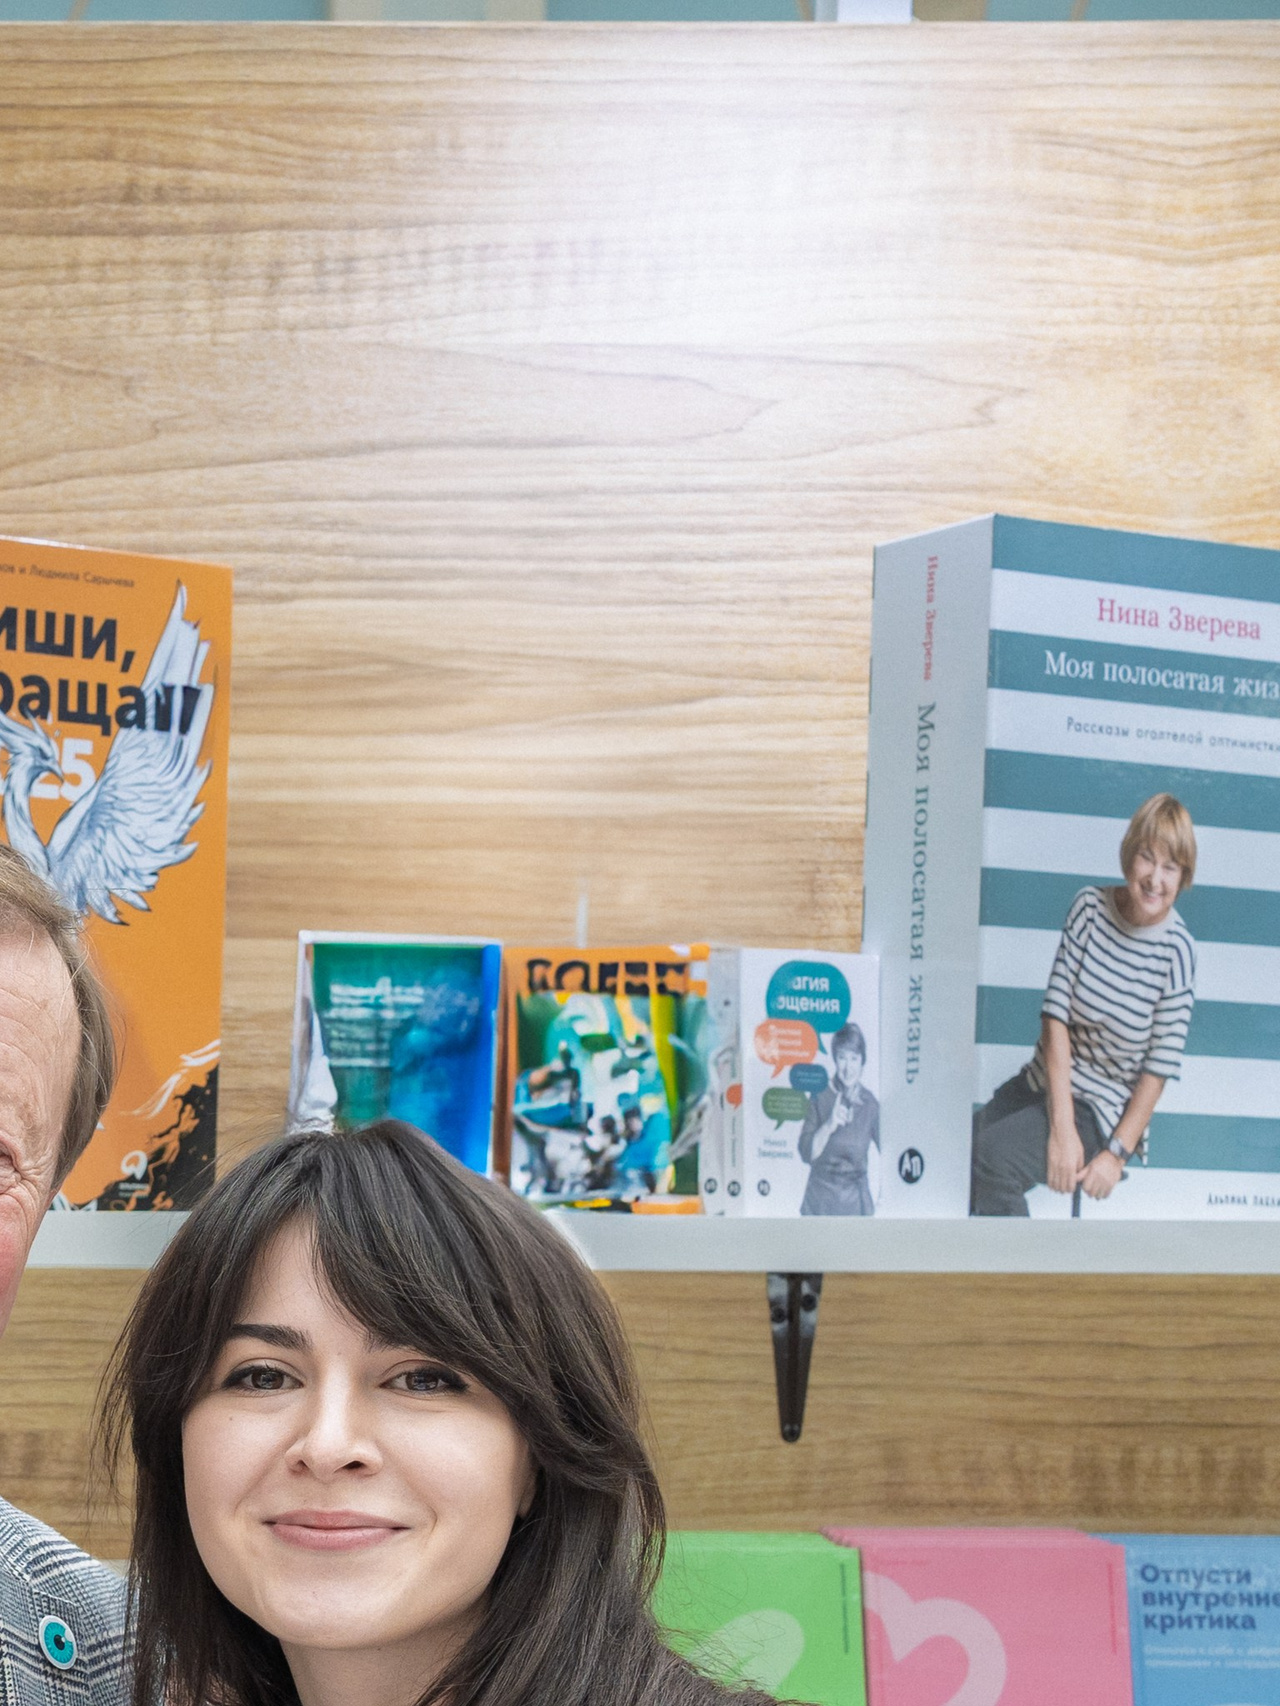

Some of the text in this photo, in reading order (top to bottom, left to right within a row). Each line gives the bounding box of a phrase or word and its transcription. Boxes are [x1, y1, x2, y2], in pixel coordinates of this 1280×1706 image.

[1097, 597, 1262, 642] Нина Зверева
[1044, 650, 1094, 680] Моя
[1103, 661, 1225, 694] полосатая
[1066, 716, 1130, 738] Рассказы
[906, 702, 937, 1085] Моя полосатая жизнь
[1140, 1563, 1252, 1589] Отпусти
[1143, 1613, 1257, 1635] критика
